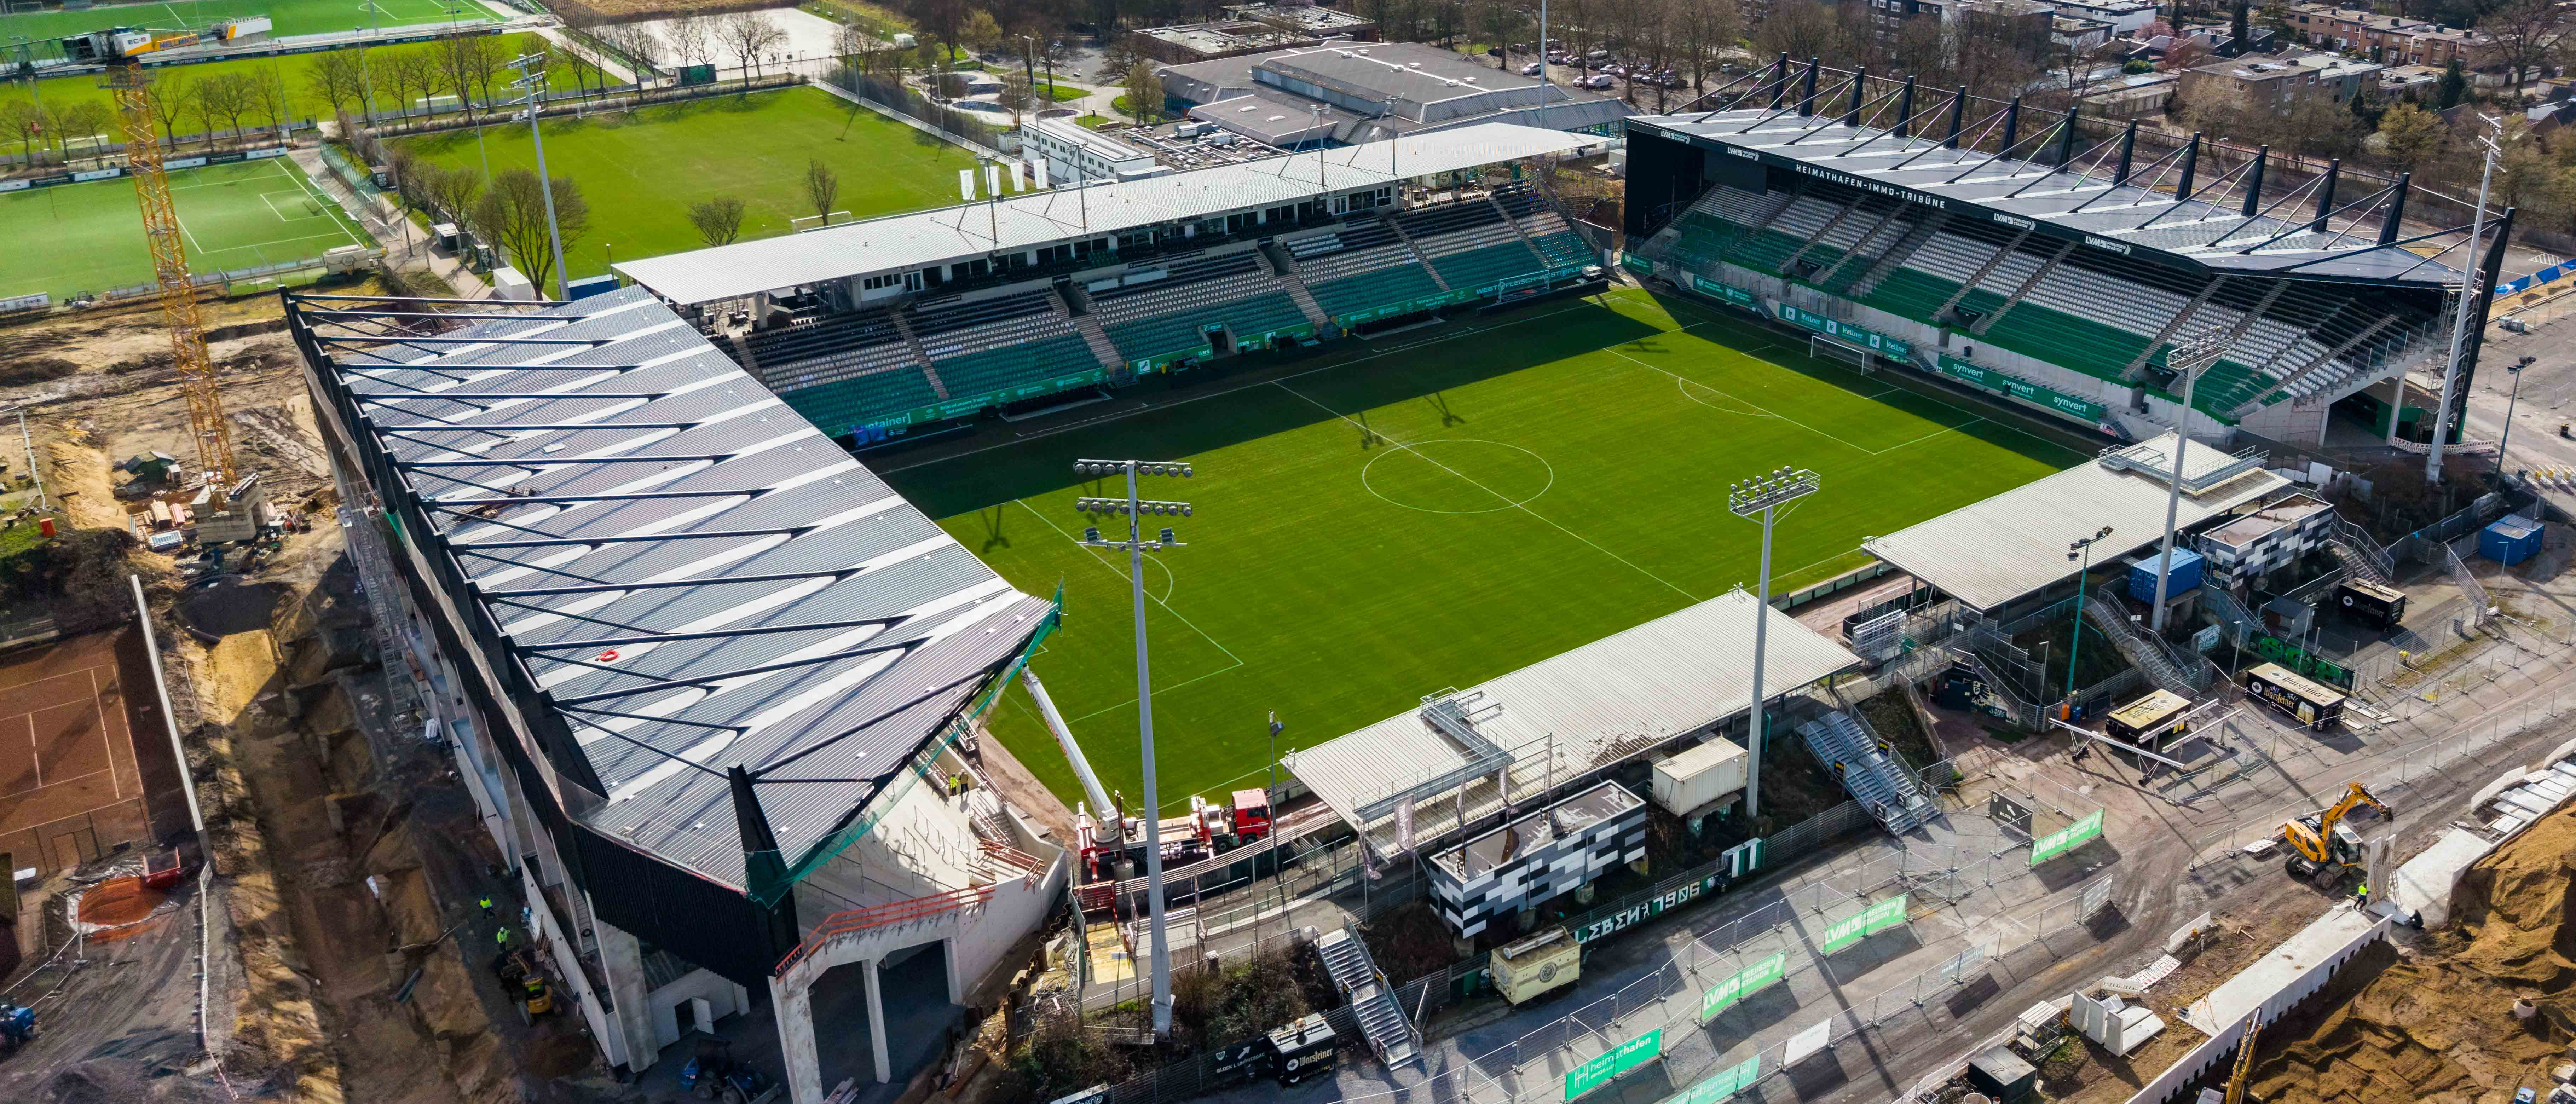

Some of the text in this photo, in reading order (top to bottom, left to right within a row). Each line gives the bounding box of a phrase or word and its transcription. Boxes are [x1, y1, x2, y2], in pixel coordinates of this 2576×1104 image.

[1728, 146, 1738, 155] LVM
[1796, 164, 1945, 208] HEIMATHAFEN-IMMO-TRIBÜNE
[1994, 213, 2008, 224] LVM
[2086, 236, 2101, 247] LVM
[1477, 285, 1499, 294] WEST
[1953, 363, 1983, 378] synvert
[2054, 396, 2087, 413] synvert
[2033, 836, 2057, 857] LVM
[1825, 919, 1851, 944] LVM
[1742, 958, 1776, 979] PREUSSEN
[1704, 982, 1729, 1011] LVM
[1300, 1048, 1333, 1067] Warsteiner
[1591, 1037, 1651, 1072] heimathafen
